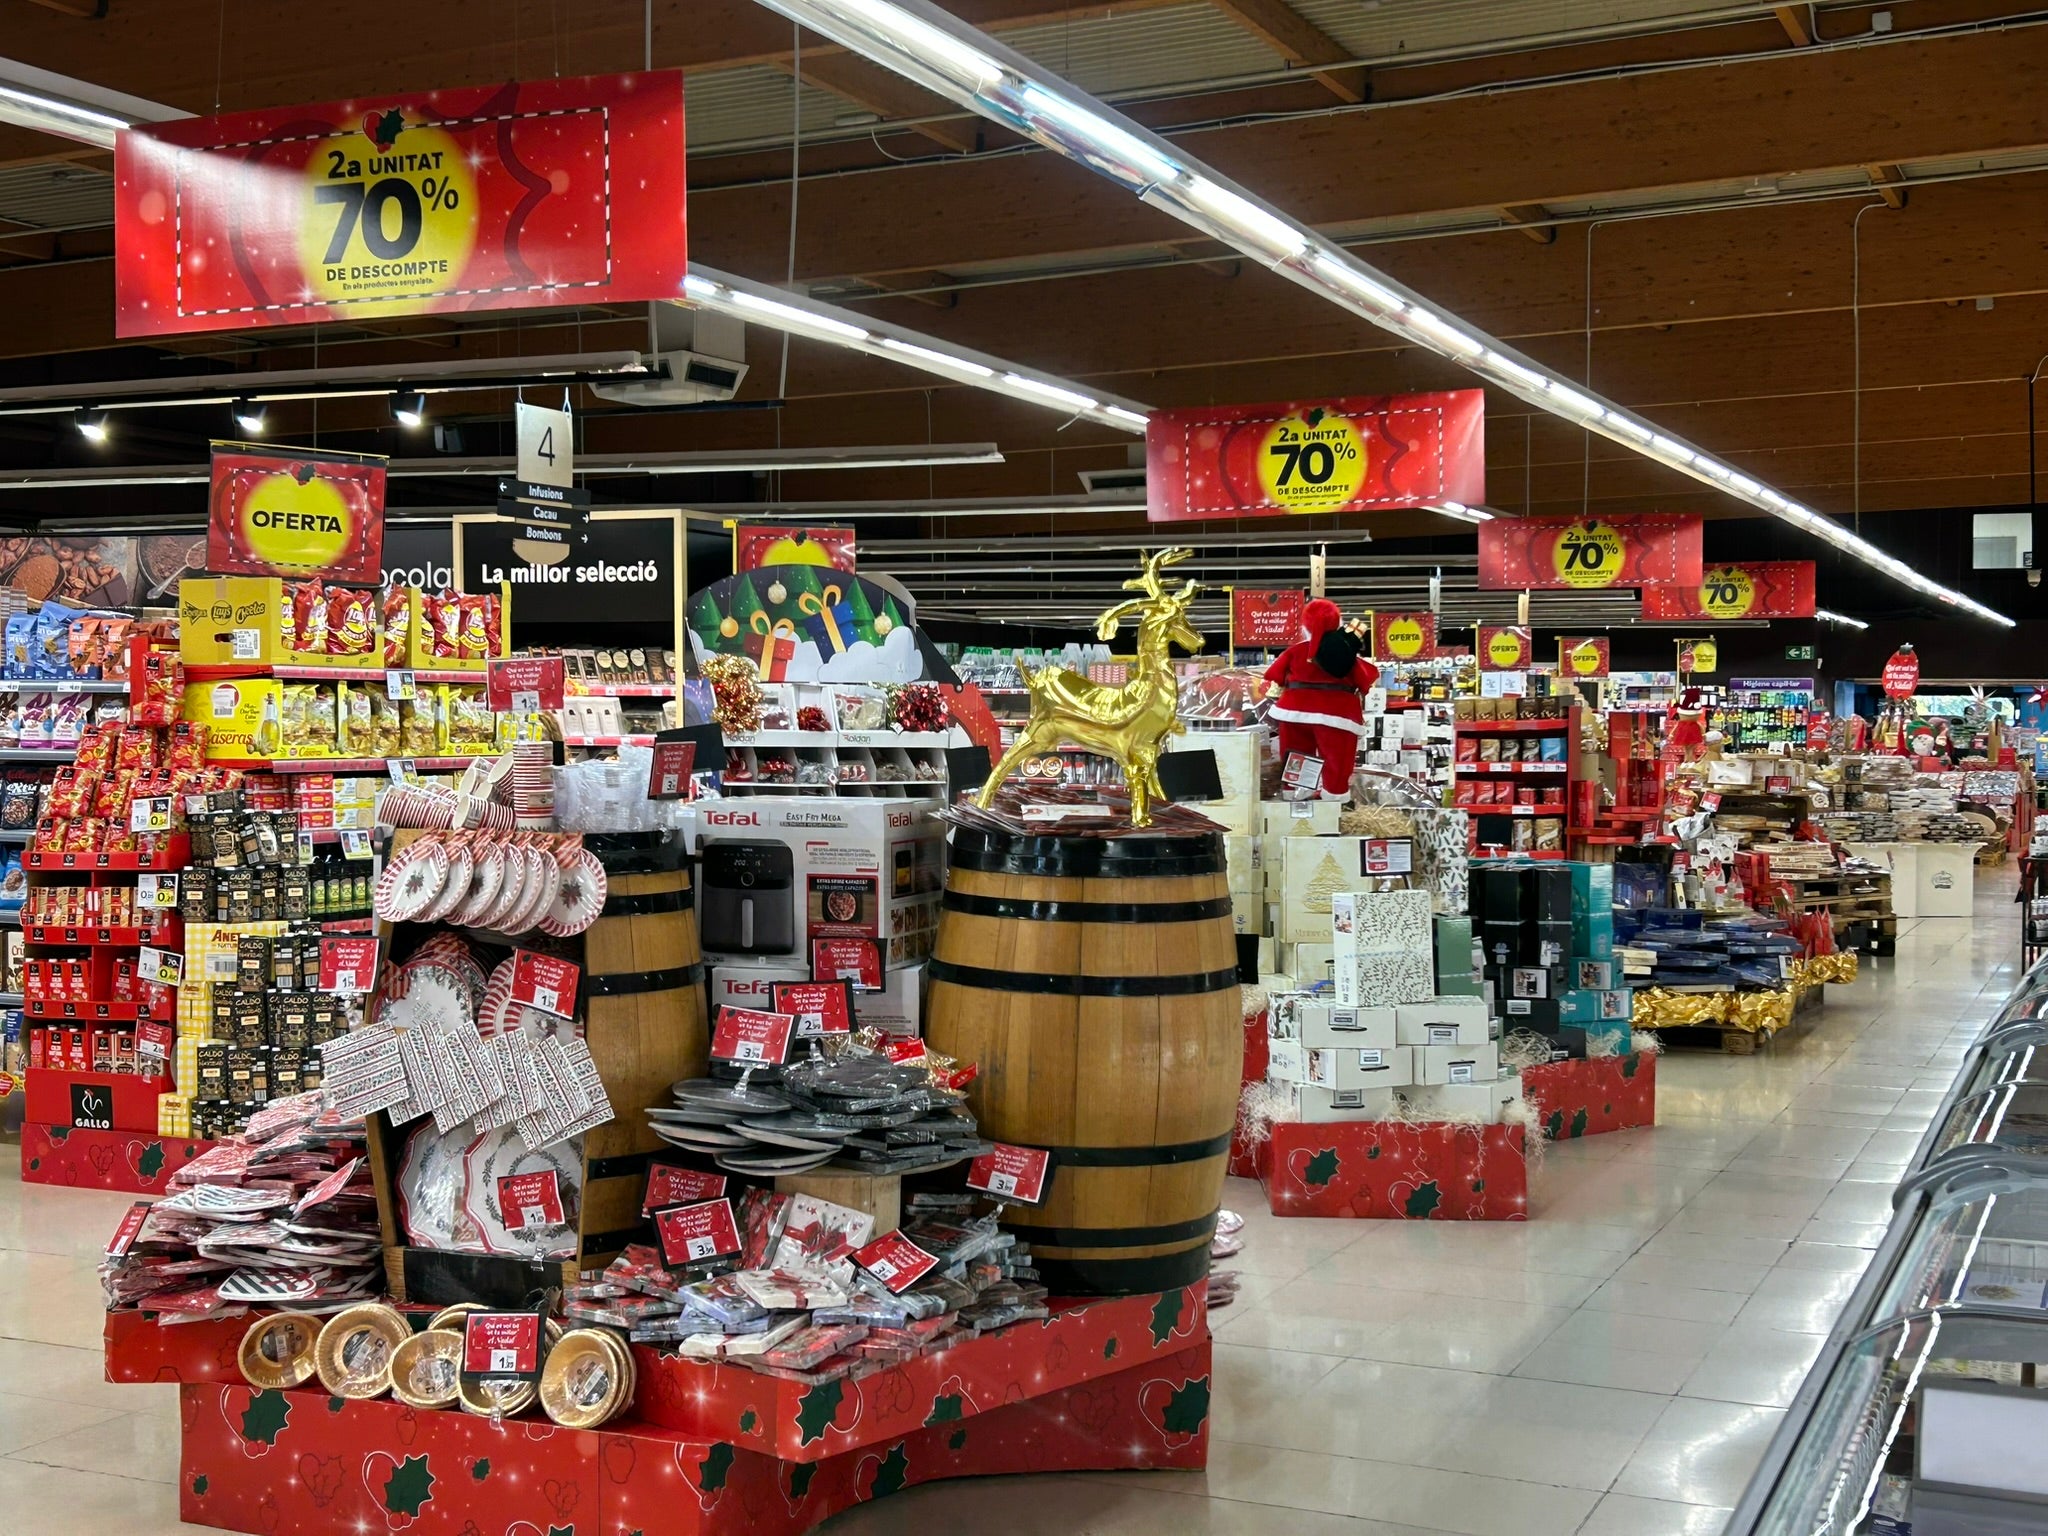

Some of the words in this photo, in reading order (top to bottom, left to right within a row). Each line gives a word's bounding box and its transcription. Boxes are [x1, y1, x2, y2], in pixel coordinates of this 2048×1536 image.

[328, 150, 361, 179] 2a
[369, 152, 444, 175] UNITAT
[314, 176, 459, 265] 70%
[326, 268, 346, 282] DE
[351, 260, 448, 280] DESCOMPTE
[1278, 427, 1299, 442] 2a
[1303, 429, 1347, 441] UNITAT
[538, 426, 555, 467] 4
[1270, 441, 1356, 486] 70%
[529, 485, 564, 500] Infusions
[1278, 487, 1290, 495] DE
[1293, 485, 1349, 495] DESCOMPTE
[533, 506, 557, 520] Cacau
[252, 511, 342, 533] OFERTA
[526, 526, 562, 541] Bombons
[1567, 531, 1580, 541] 2a
[1561, 542, 1618, 570] 70%
[482, 563, 503, 583] La
[510, 563, 570, 583] millor
[576, 560, 658, 584] selecció
[1705, 583, 1750, 604] 70%
[1389, 633, 1420, 642] OFERTA
[1743, 680, 1771, 689] Higiene
[703, 810, 761, 826] Tefal
[786, 812, 803, 821] EASY
[821, 813, 842, 821] MEGA
[887, 811, 913, 828] Tefal
[183, 873, 206, 881] CALDO
[230, 873, 250, 881] CALDO
[284, 870, 306, 878] CALDO
[212, 929, 242, 942] ANET
[239, 941, 264, 950] CALDO
[215, 989, 233, 997] CALDO
[722, 980, 770, 994] Tefa
[236, 997, 261, 1006] CALDO
[283, 997, 309, 1005] CALDO
[313, 995, 335, 1003] CALDO
[199, 1050, 223, 1058] CALDO
[274, 1052, 299, 1061] CALDO
[75, 1118, 109, 1129] GALLO
